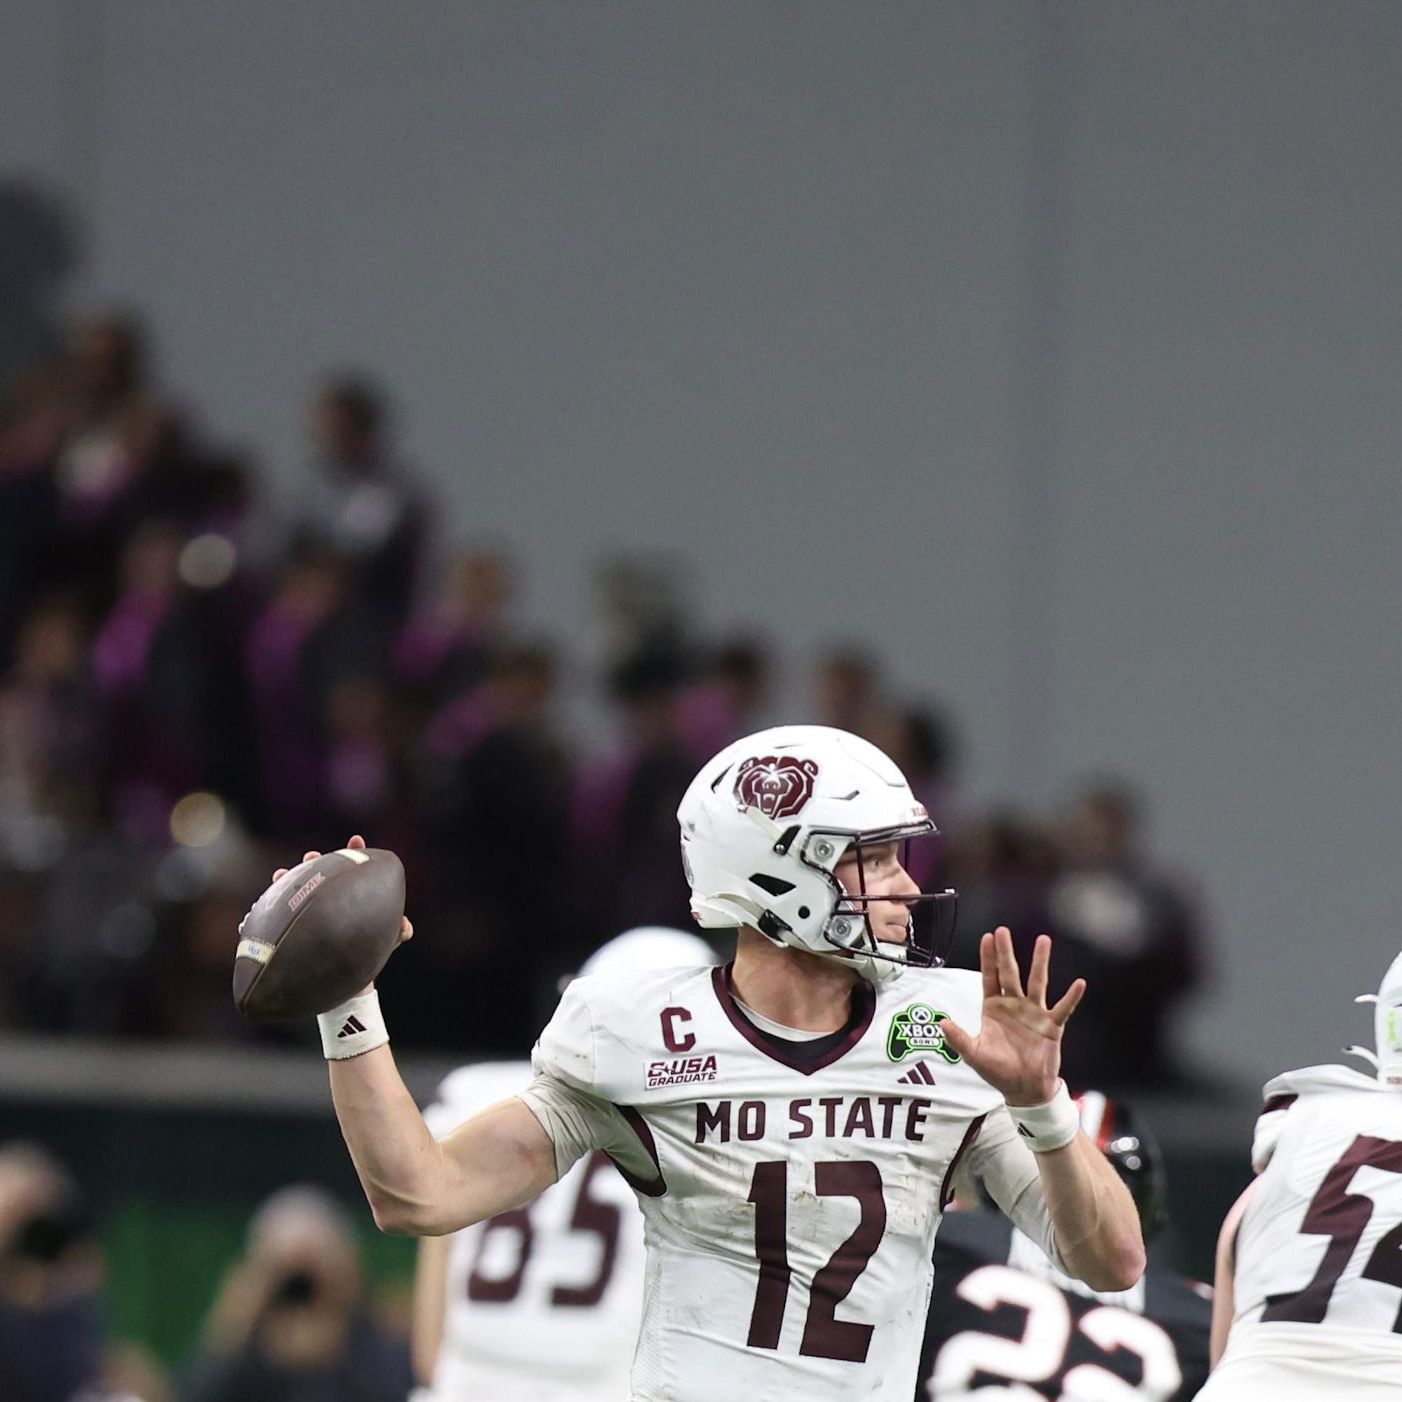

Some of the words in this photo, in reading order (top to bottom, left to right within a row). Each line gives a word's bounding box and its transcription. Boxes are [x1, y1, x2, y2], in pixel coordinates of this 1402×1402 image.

[660, 1007, 696, 1052] C
[901, 1024, 946, 1037] XBOX
[648, 1072, 718, 1087] GRADUATE
[695, 1101, 766, 1143] MO
[788, 1097, 932, 1142] STATE
[747, 1160, 887, 1363] 12
